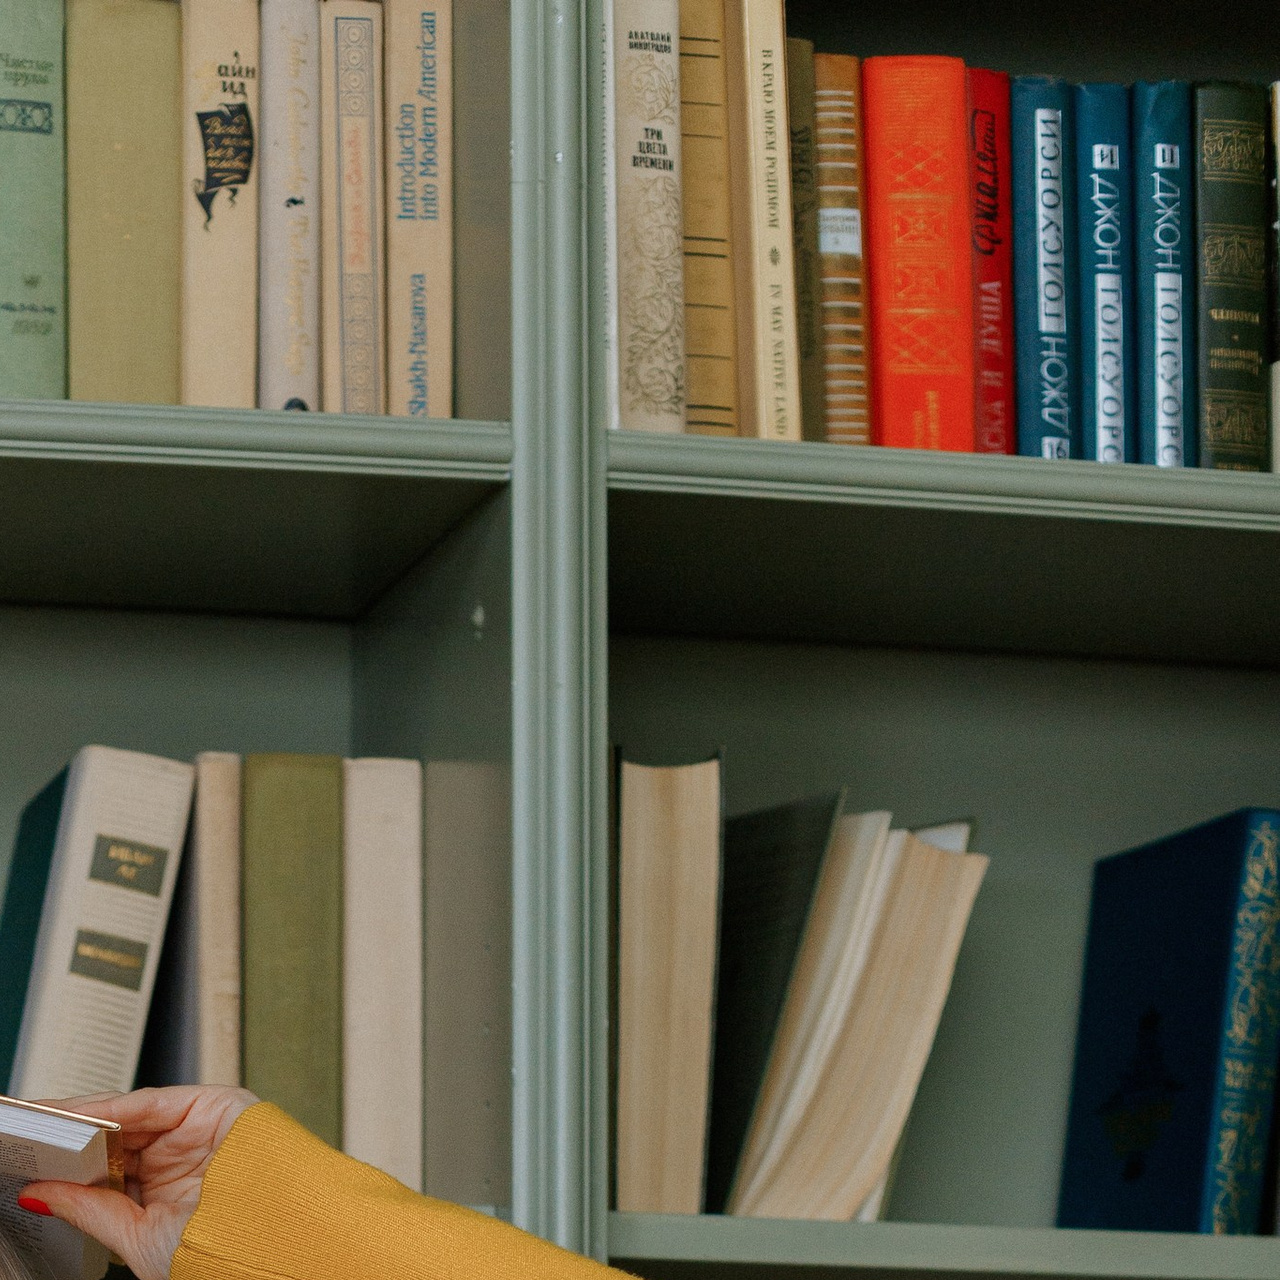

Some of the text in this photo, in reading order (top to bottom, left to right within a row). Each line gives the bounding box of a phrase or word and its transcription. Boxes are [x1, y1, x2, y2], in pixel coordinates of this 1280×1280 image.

[3, 67, 49, 89] пруды
[416, 11, 439, 221] into Modern American
[395, 103, 417, 221] Introduction
[631, 155, 675, 172] ВРЕМЕНИ
[638, 141, 669, 156] ЦВЕТА
[643, 127, 663, 141] ТРИ
[761, 48, 780, 230] В КРАЮ МОЕМ РОДИМОМ
[1041, 117, 1065, 319] ГОЛСУОРСИ
[1090, 171, 1120, 269] ДЖОН
[1151, 171, 1180, 269] ДЖОН
[772, 339, 786, 391] NATIVE
[979, 280, 1004, 356] ДУША
[1040, 336, 1069, 426] ДЖОН
[1100, 287, 1122, 462] ГОЛСУОРС
[1159, 287, 1181, 463] ГОЛСУОРС
